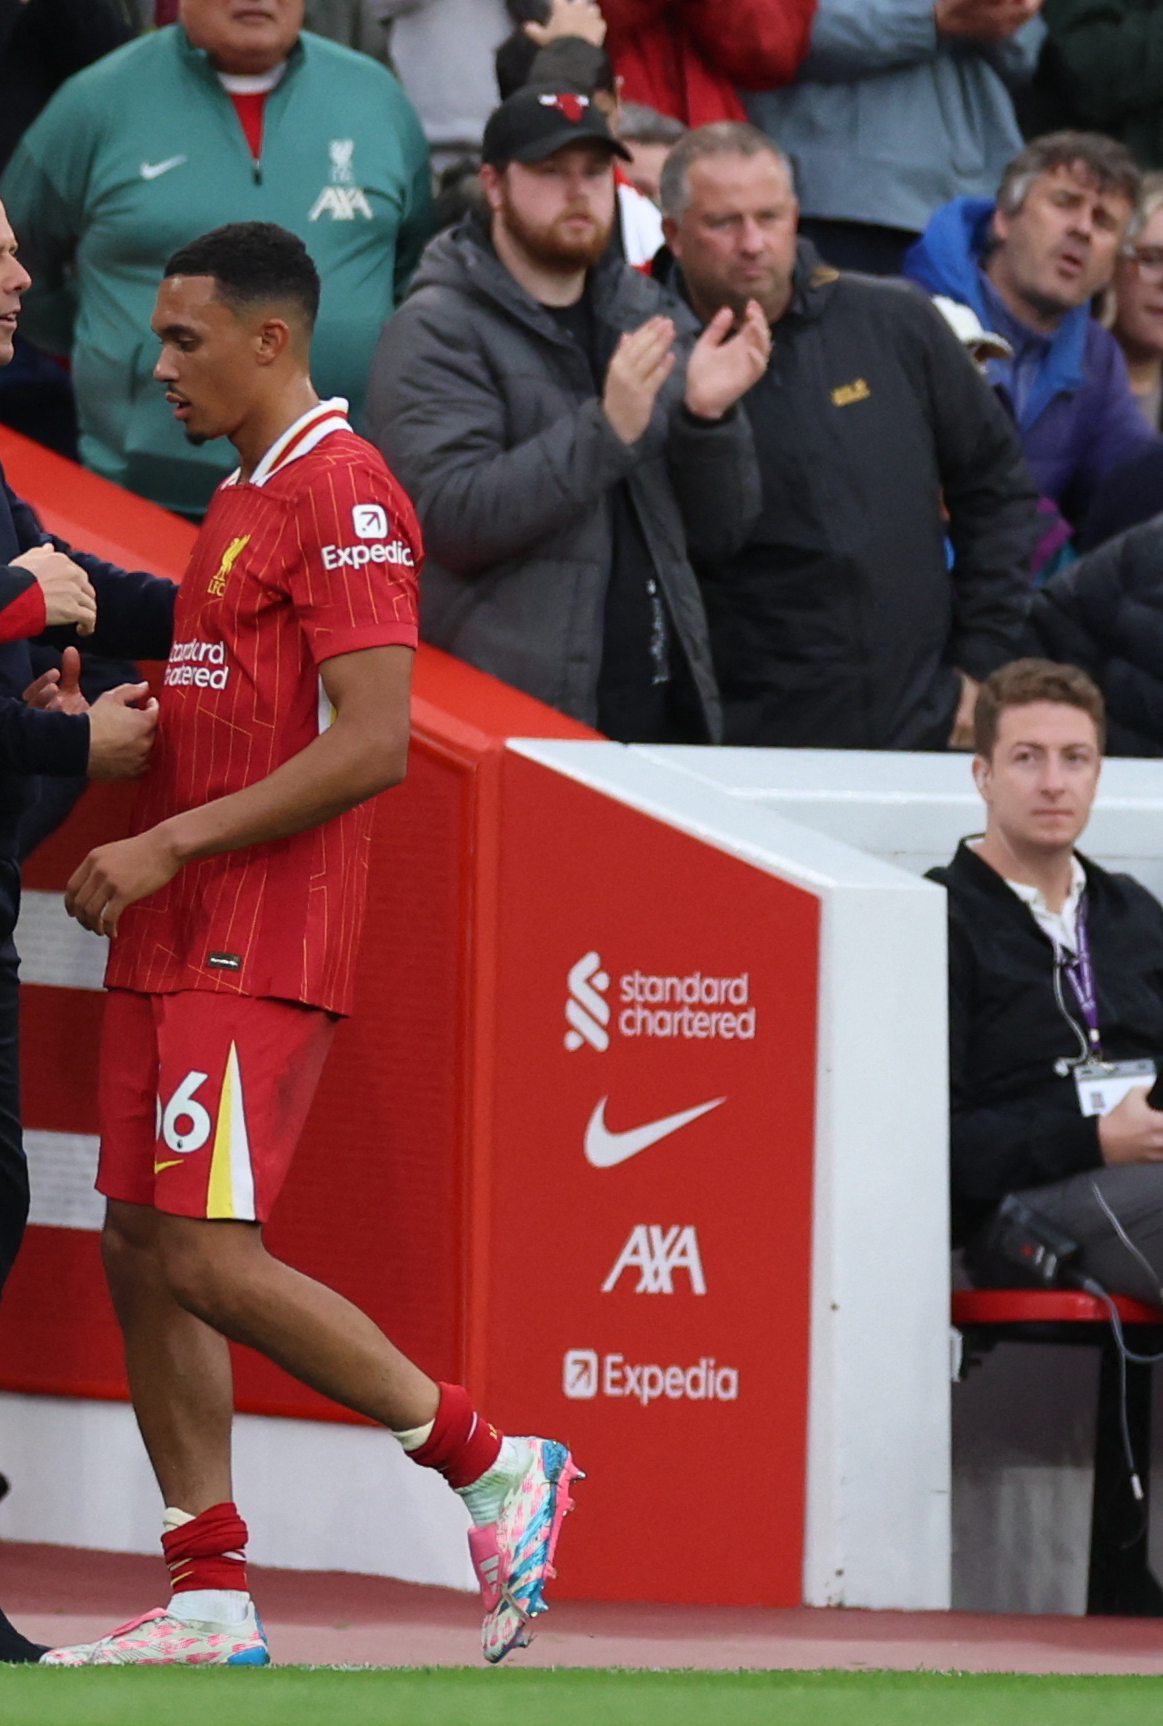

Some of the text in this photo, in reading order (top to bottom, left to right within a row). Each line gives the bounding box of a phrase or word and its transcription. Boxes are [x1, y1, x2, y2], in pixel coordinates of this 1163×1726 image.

[309, 187, 374, 221] AXA
[207, 579, 226, 597] LFC
[620, 969, 749, 1005] standard
[618, 1004, 756, 1040] chartered
[155, 1070, 212, 1154] 6
[601, 1223, 707, 1296] AXA
[603, 1352, 739, 1406] Expedia
